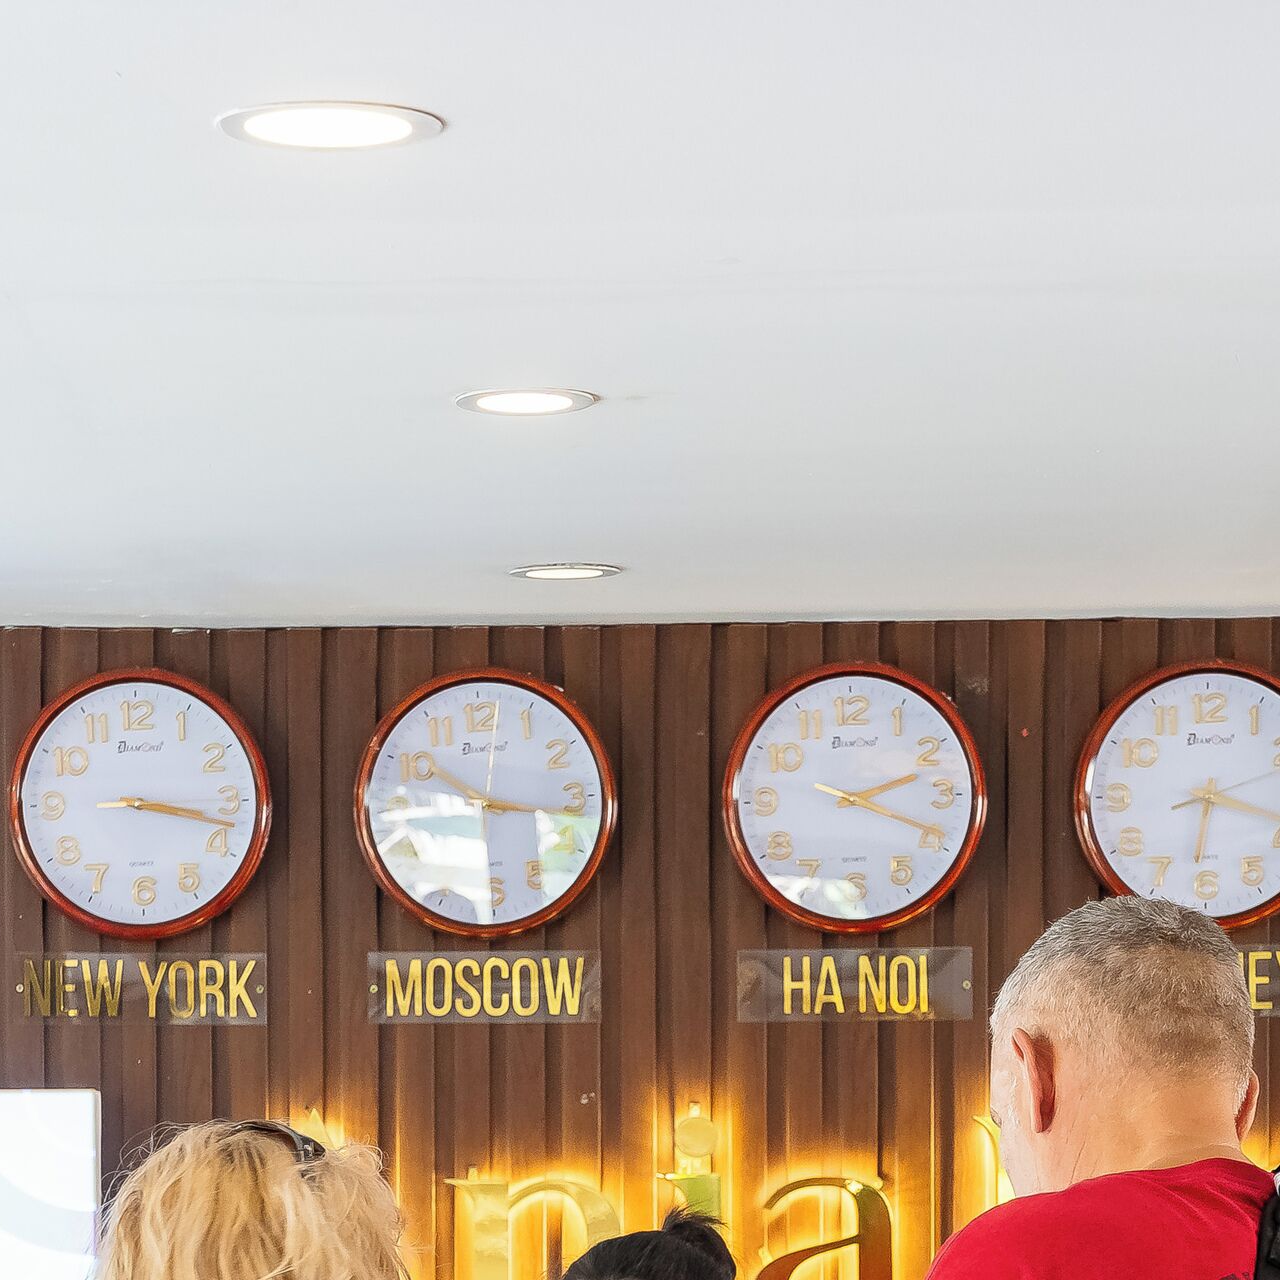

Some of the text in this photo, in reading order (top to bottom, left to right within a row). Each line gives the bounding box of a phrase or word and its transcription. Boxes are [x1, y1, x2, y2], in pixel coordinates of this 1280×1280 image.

[120, 700, 154, 731] 12
[464, 702, 499, 732] 12
[521, 708, 532, 739] 1
[834, 696, 869, 726] 12
[892, 707, 902, 736] 1
[1154, 705, 1177, 735] 11
[1192, 693, 1228, 724] 12
[1249, 705, 1260, 735] 1
[85, 712, 108, 743] 11
[176, 711, 186, 741] 1
[428, 716, 453, 747] 11
[799, 709, 821, 740] 11
[53, 746, 89, 776] 10
[203, 743, 225, 773] 2
[545, 739, 570, 770] 2
[769, 743, 804, 773] 10
[917, 736, 941, 766] 2
[1122, 738, 1158, 768] 10
[400, 751, 436, 783] 10
[41, 791, 65, 820] 9
[218, 785, 240, 815] 3
[563, 782, 586, 813] 3
[754, 787, 778, 816] 9
[931, 779, 954, 809] 3
[1106, 783, 1131, 812] 9
[56, 836, 81, 865] 8
[206, 828, 228, 857] 4
[768, 831, 792, 860] 8
[1119, 827, 1143, 856] 8
[84, 864, 109, 894] 7
[178, 863, 200, 893] 5
[526, 860, 544, 890] 5
[890, 856, 912, 885] 5
[1147, 856, 1172, 887] 7
[1194, 870, 1218, 900] 6
[1241, 856, 1263, 886] 5
[132, 876, 156, 906] 6
[23, 959, 257, 1019] NEW YORK
[385, 957, 585, 1019] MOSCOW
[782, 954, 928, 1015] HA NOI
